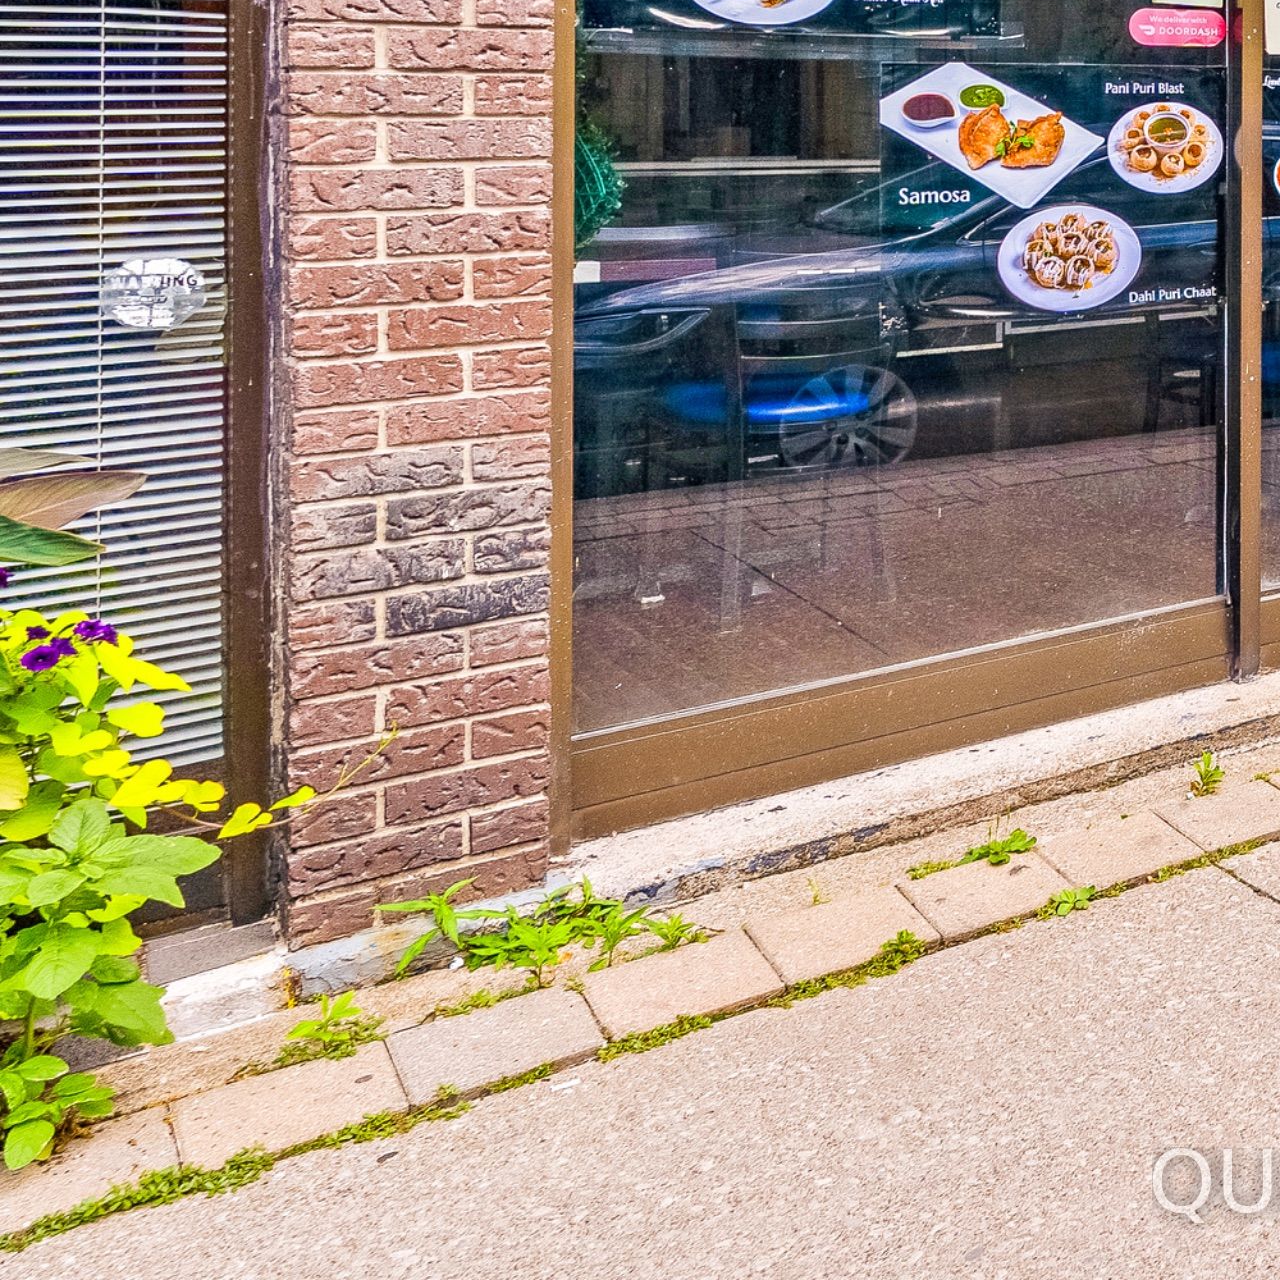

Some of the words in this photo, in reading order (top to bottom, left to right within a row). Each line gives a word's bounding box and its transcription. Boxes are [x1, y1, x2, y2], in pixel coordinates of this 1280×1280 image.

[1159, 26, 1218, 36] DOORDASH
[1132, 82, 1155, 94] Puri
[1158, 81, 1185, 94] Blast
[898, 187, 971, 206] Samosa
[1158, 288, 1181, 303] Puri
[1183, 285, 1217, 299] Chaat
